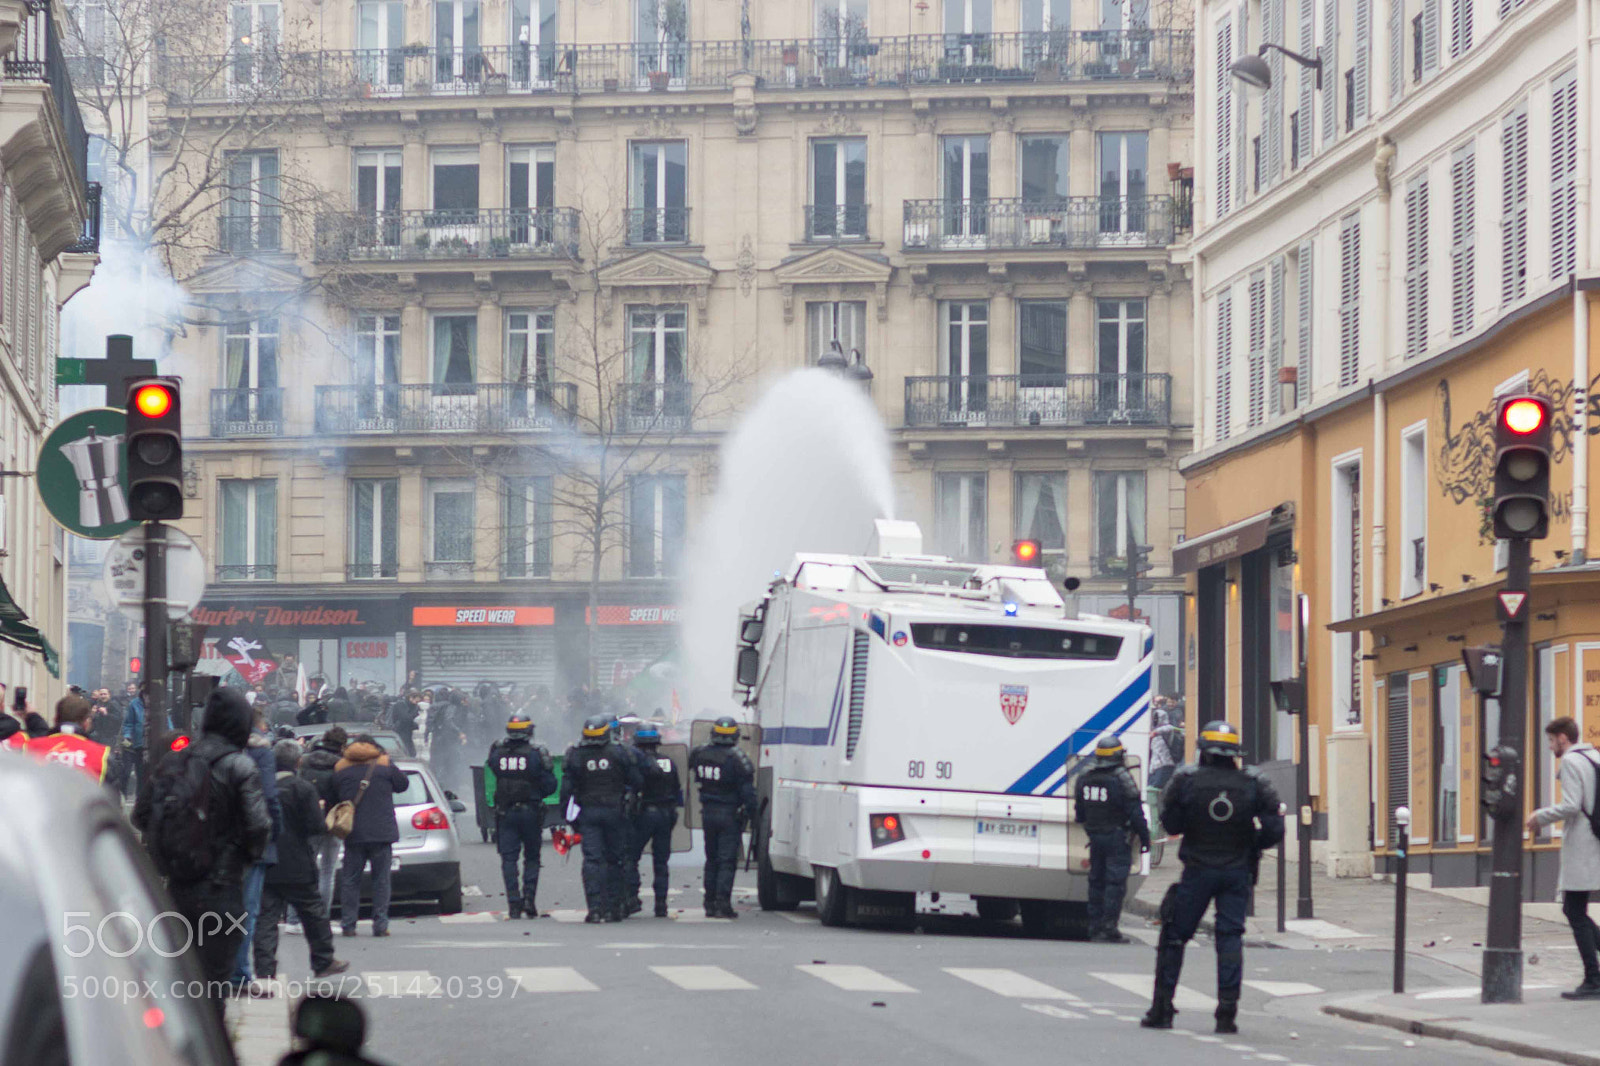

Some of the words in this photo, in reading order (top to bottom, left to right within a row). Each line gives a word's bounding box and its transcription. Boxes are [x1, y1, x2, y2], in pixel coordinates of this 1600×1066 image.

[456, 609, 487, 623] SPEED
[488, 610, 516, 624] WEAR
[629, 608, 659, 622] SPEED
[346, 641, 389, 658] ESSAIS
[1000, 694, 1027, 707] CRS
[908, 760, 925, 779] 80
[936, 761, 952, 779] 90
